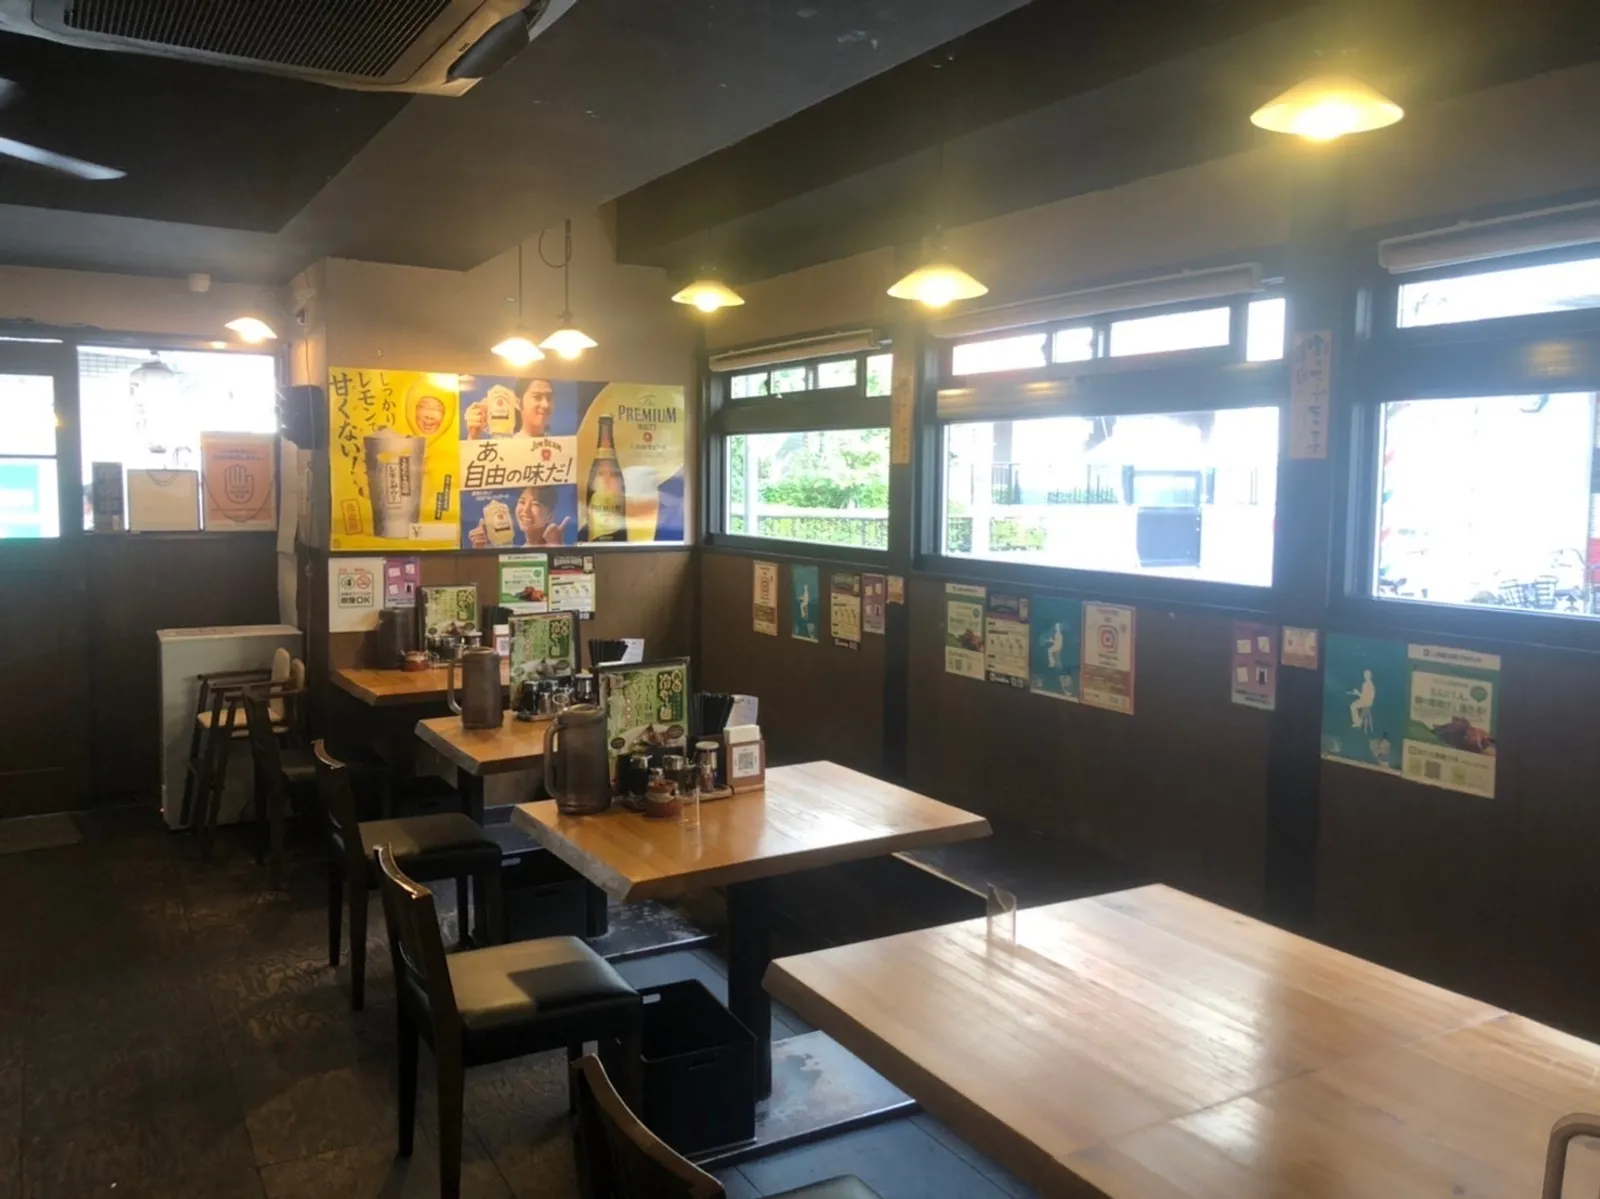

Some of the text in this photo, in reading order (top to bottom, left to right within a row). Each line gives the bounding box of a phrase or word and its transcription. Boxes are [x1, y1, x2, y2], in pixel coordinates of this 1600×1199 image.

[380, 372, 397, 427] しっかり
[618, 404, 677, 424] PREMIUM
[476, 441, 504, 463] あ、
